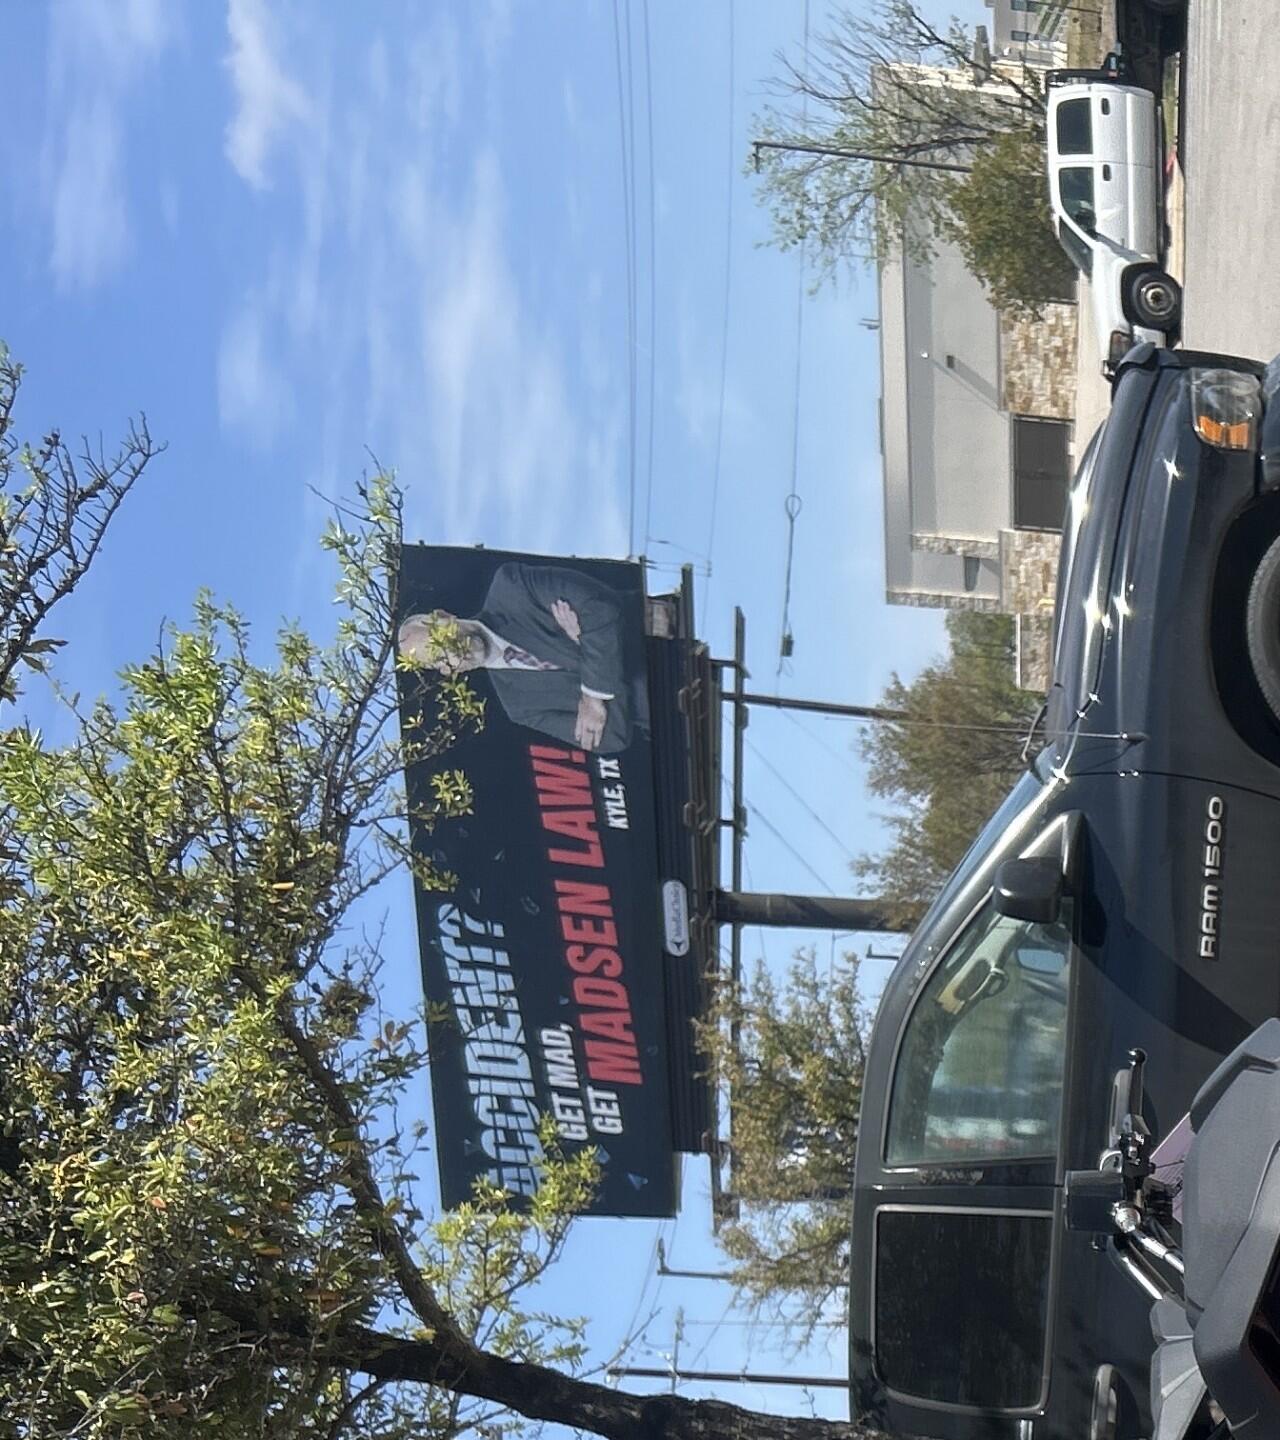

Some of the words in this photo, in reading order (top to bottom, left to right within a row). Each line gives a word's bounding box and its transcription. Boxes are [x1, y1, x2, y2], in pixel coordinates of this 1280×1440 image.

[597, 757, 621, 779] TX
[528, 744, 606, 867] LAW!
[603, 785, 630, 828] KYLE,
[1204, 796, 1223, 877] 1500
[1200, 885, 1218, 958] RAM
[554, 879, 643, 1085] MADSEN
[438, 904, 544, 1195] ACCIDENT?
[540, 1023, 575, 1087] MAD,
[550, 1093, 589, 1140] GET
[585, 1086, 624, 1134] GET
